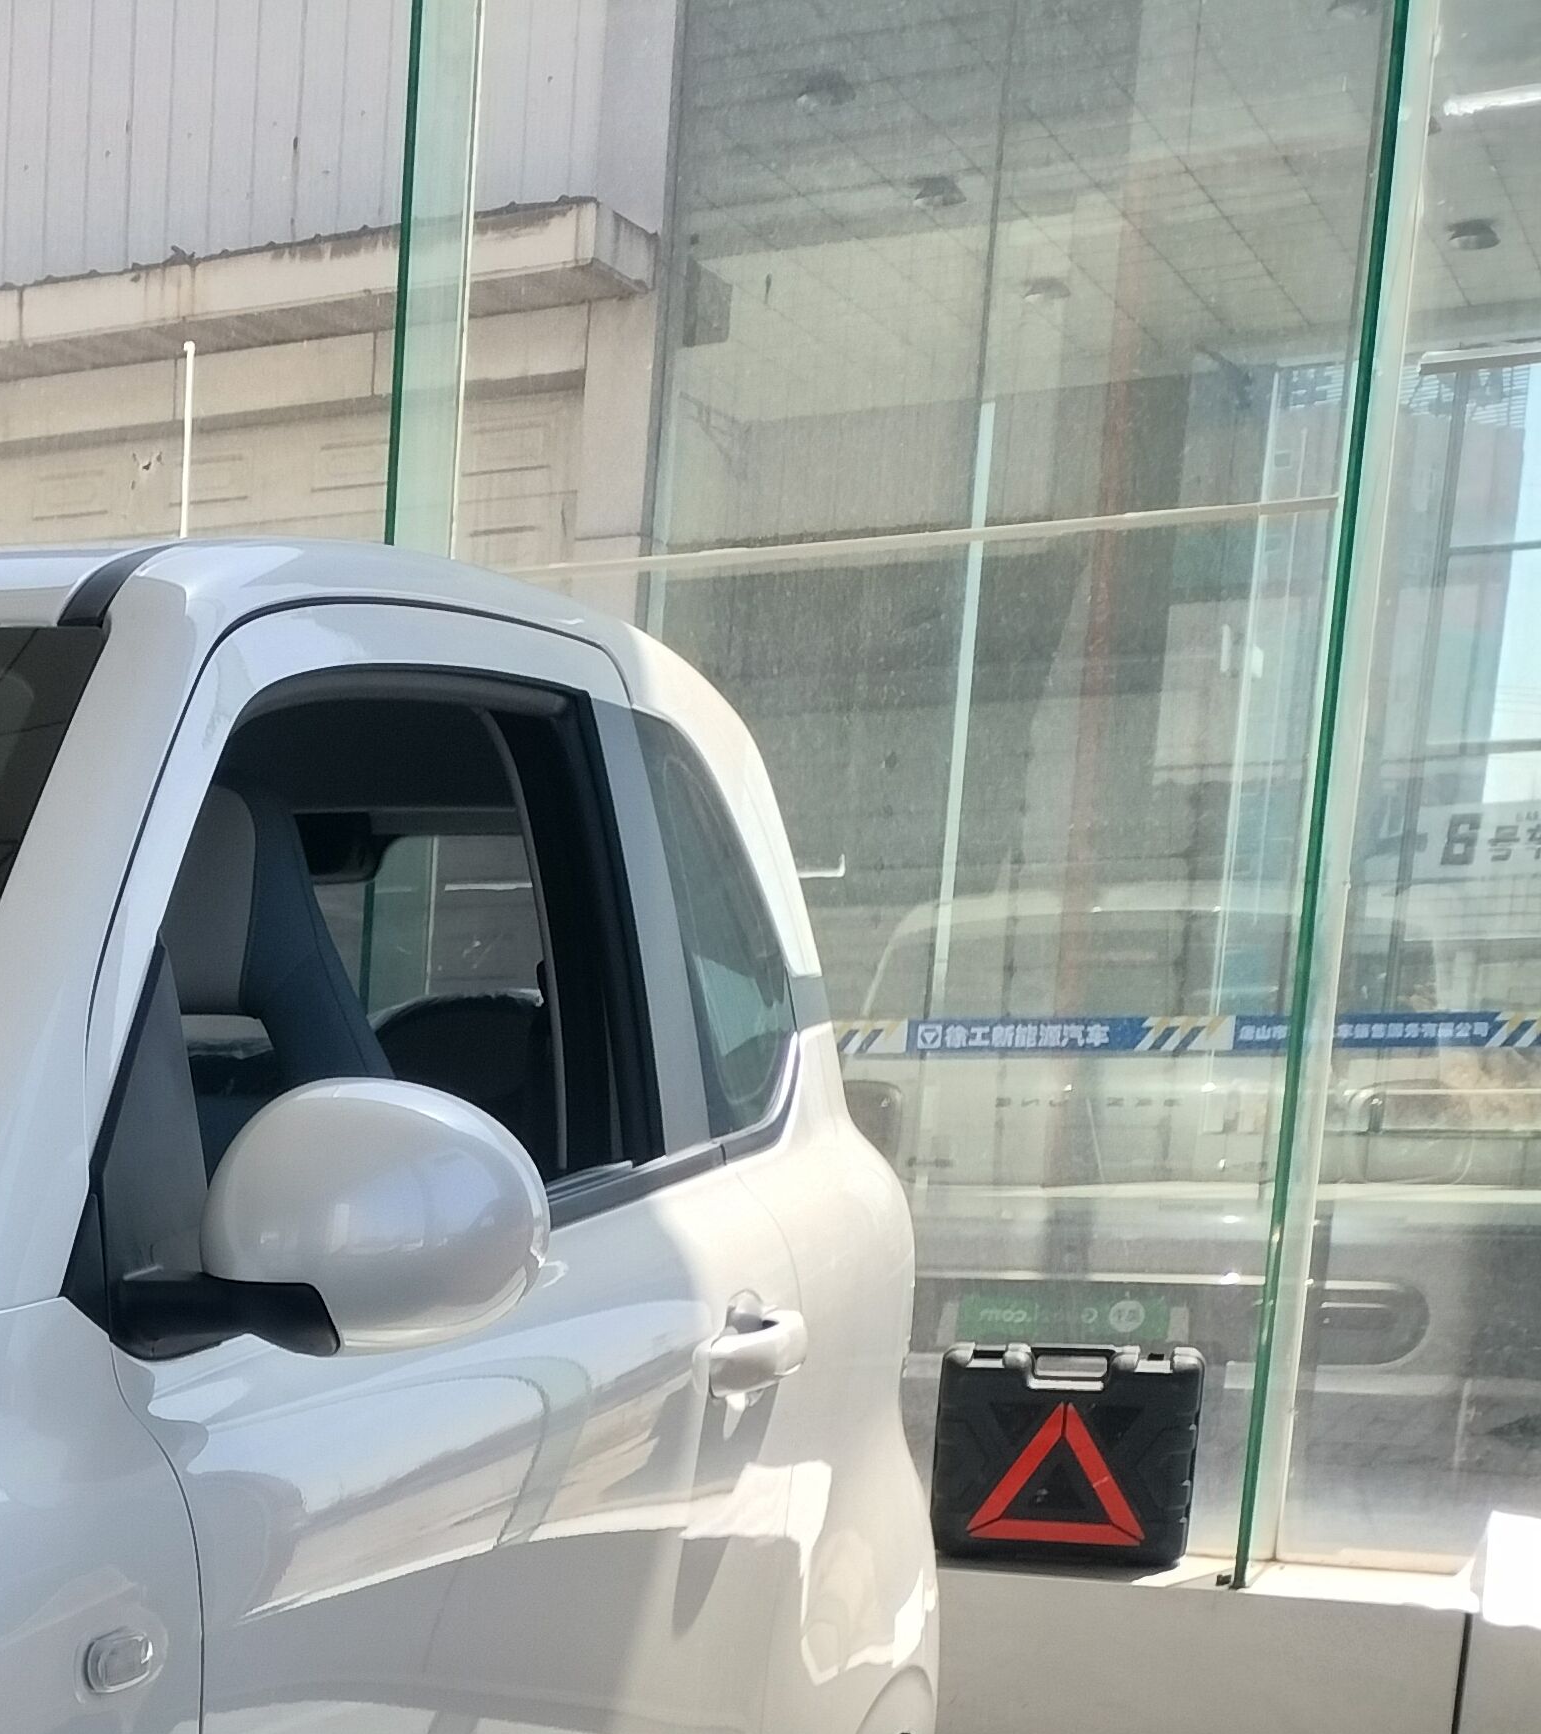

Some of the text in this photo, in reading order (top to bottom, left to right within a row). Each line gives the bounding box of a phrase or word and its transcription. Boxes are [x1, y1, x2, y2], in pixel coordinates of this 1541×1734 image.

[945, 1023, 1110, 1049] 徐工新能源汽车
[1238, 1021, 1489, 1042] 唐山市车销售服务有限公司
